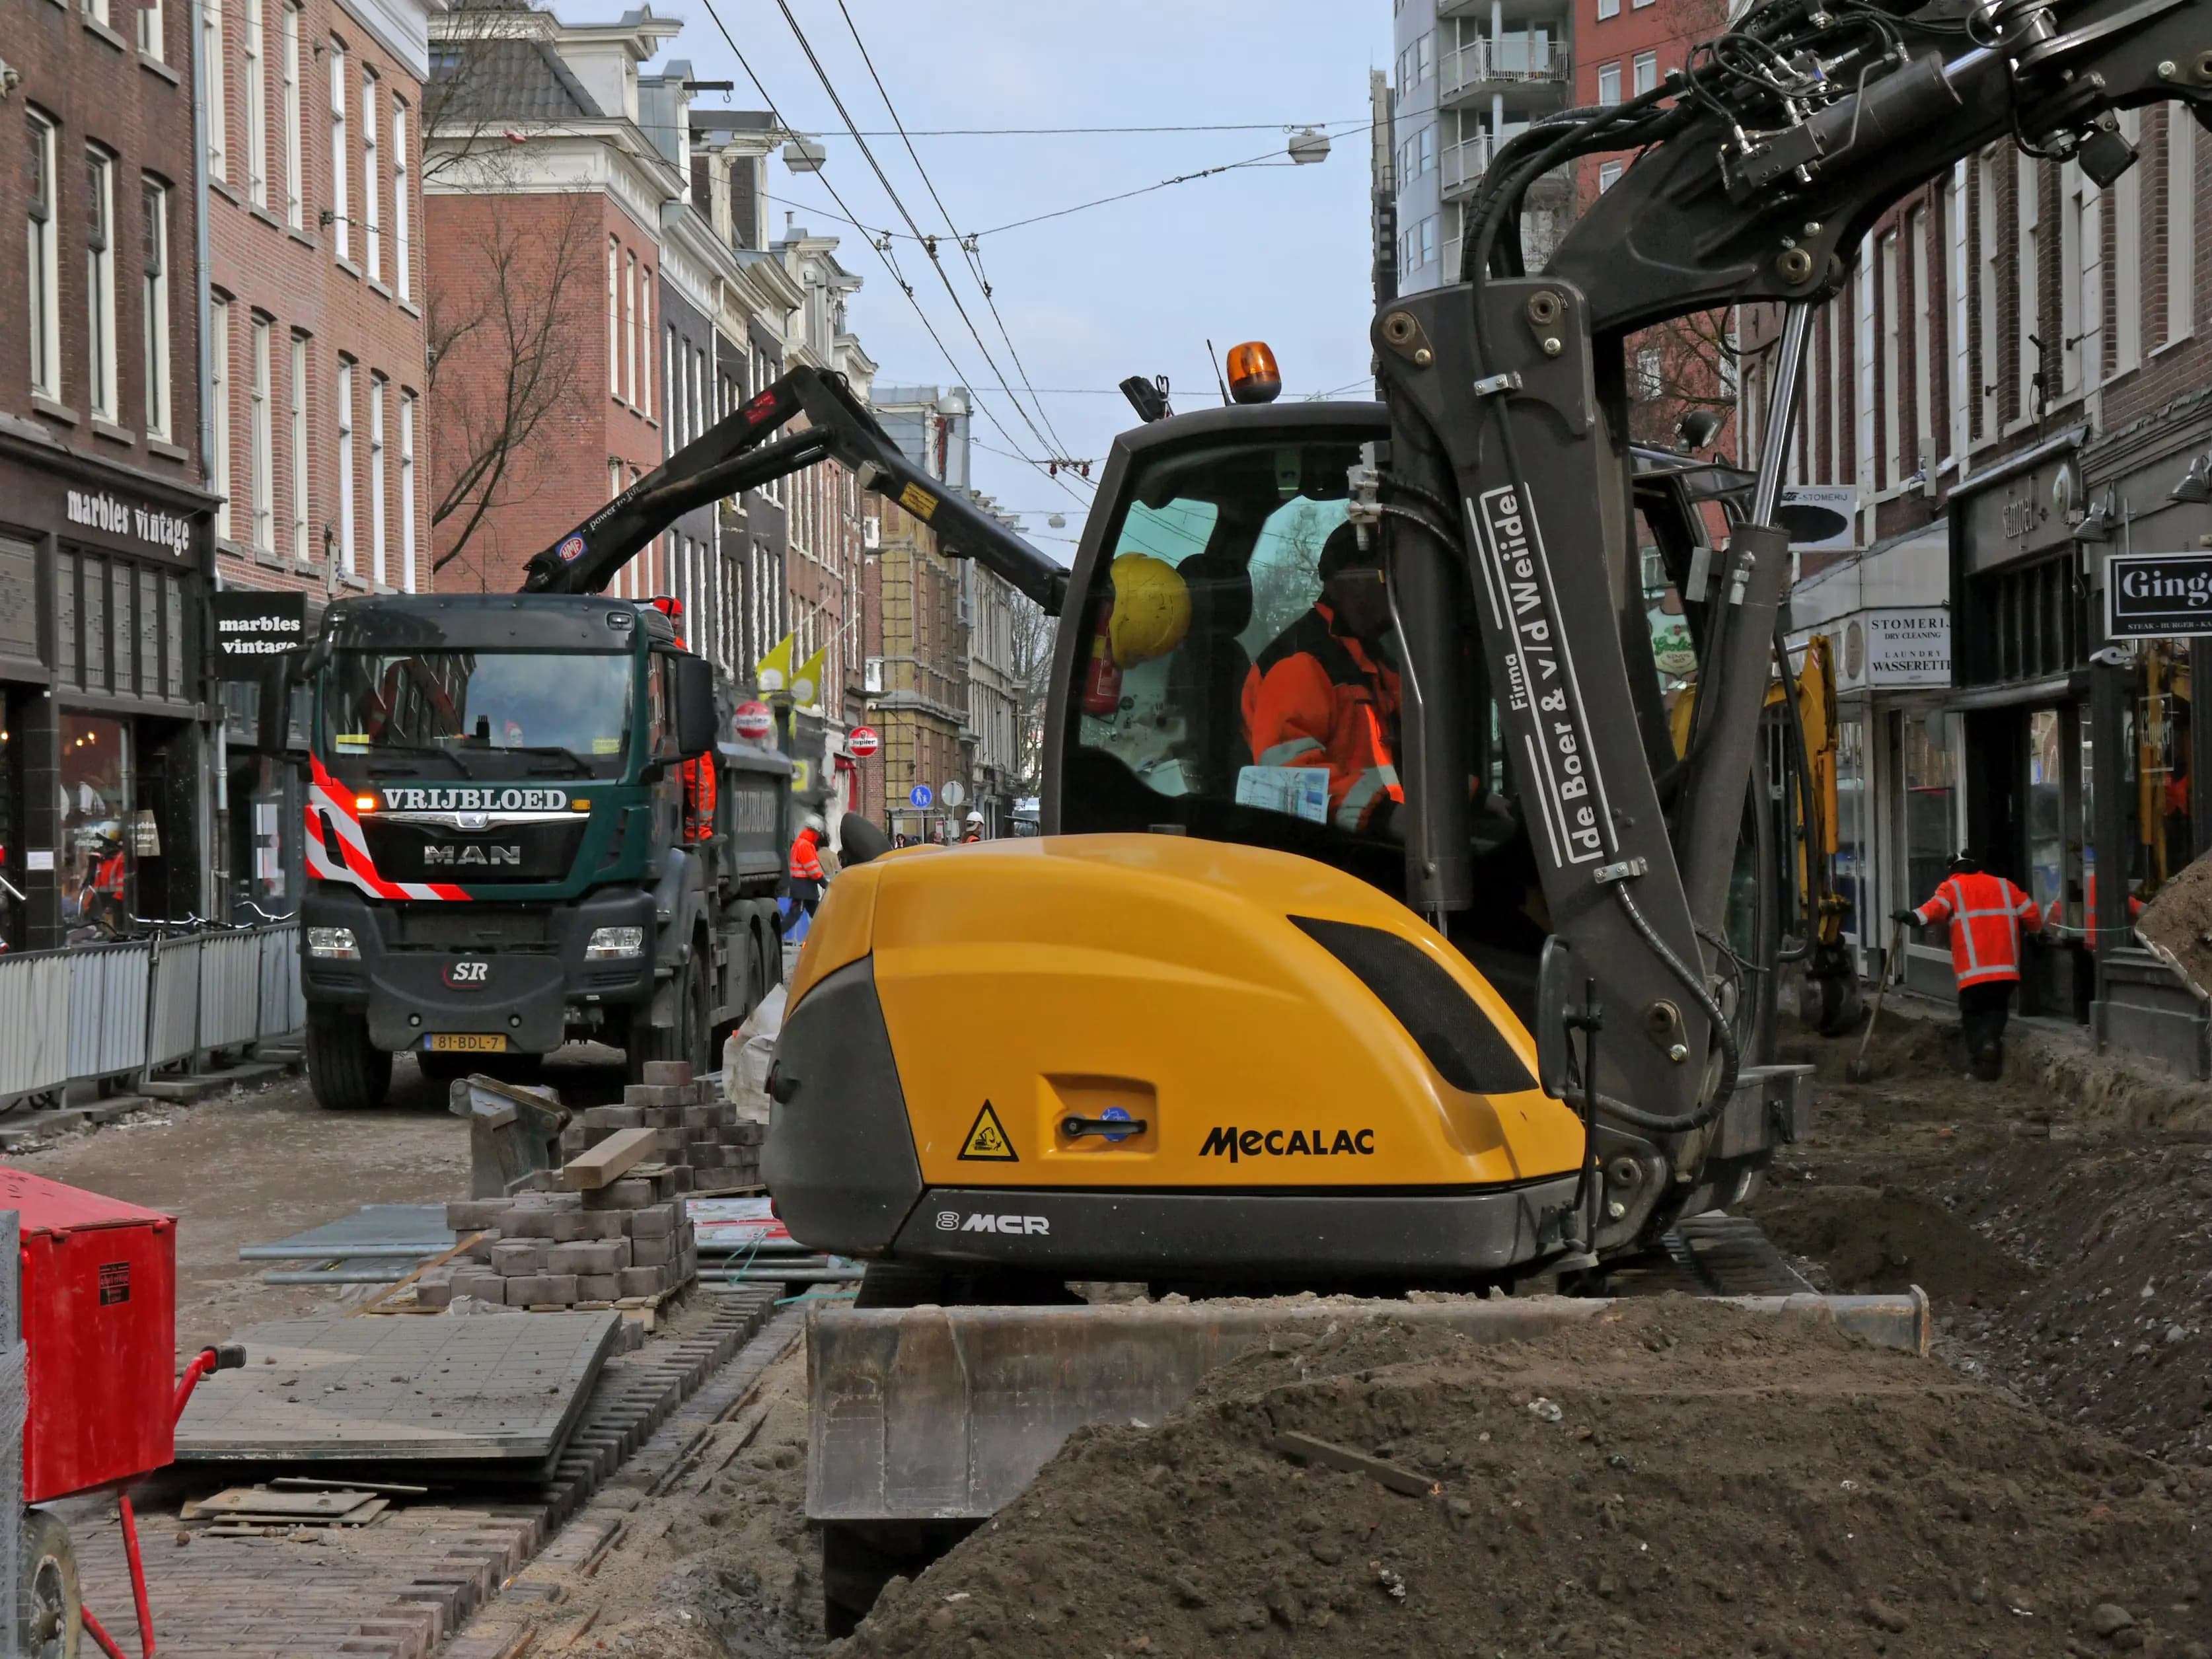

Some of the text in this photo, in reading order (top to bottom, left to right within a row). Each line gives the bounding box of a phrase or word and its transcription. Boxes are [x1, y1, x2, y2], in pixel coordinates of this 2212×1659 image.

[67, 490, 190, 556] marbles vintage
[589, 504, 616, 531] power
[562, 539, 581, 559] HMF
[219, 616, 301, 632] marbles
[1871, 618, 1950, 630] STOMERI
[1520, 624, 1558, 681] v/d
[1885, 649, 1942, 659] LAUNDRY
[1504, 653, 1528, 711] Firma
[1541, 686, 1567, 712] &
[1554, 721, 1589, 801] Boer
[383, 788, 567, 810] VRIJBLOED
[1571, 805, 1601, 850] de
[424, 845, 521, 865] MAN
[453, 962, 488, 982] SR
[438, 1035, 499, 1049] 81-BDL-7
